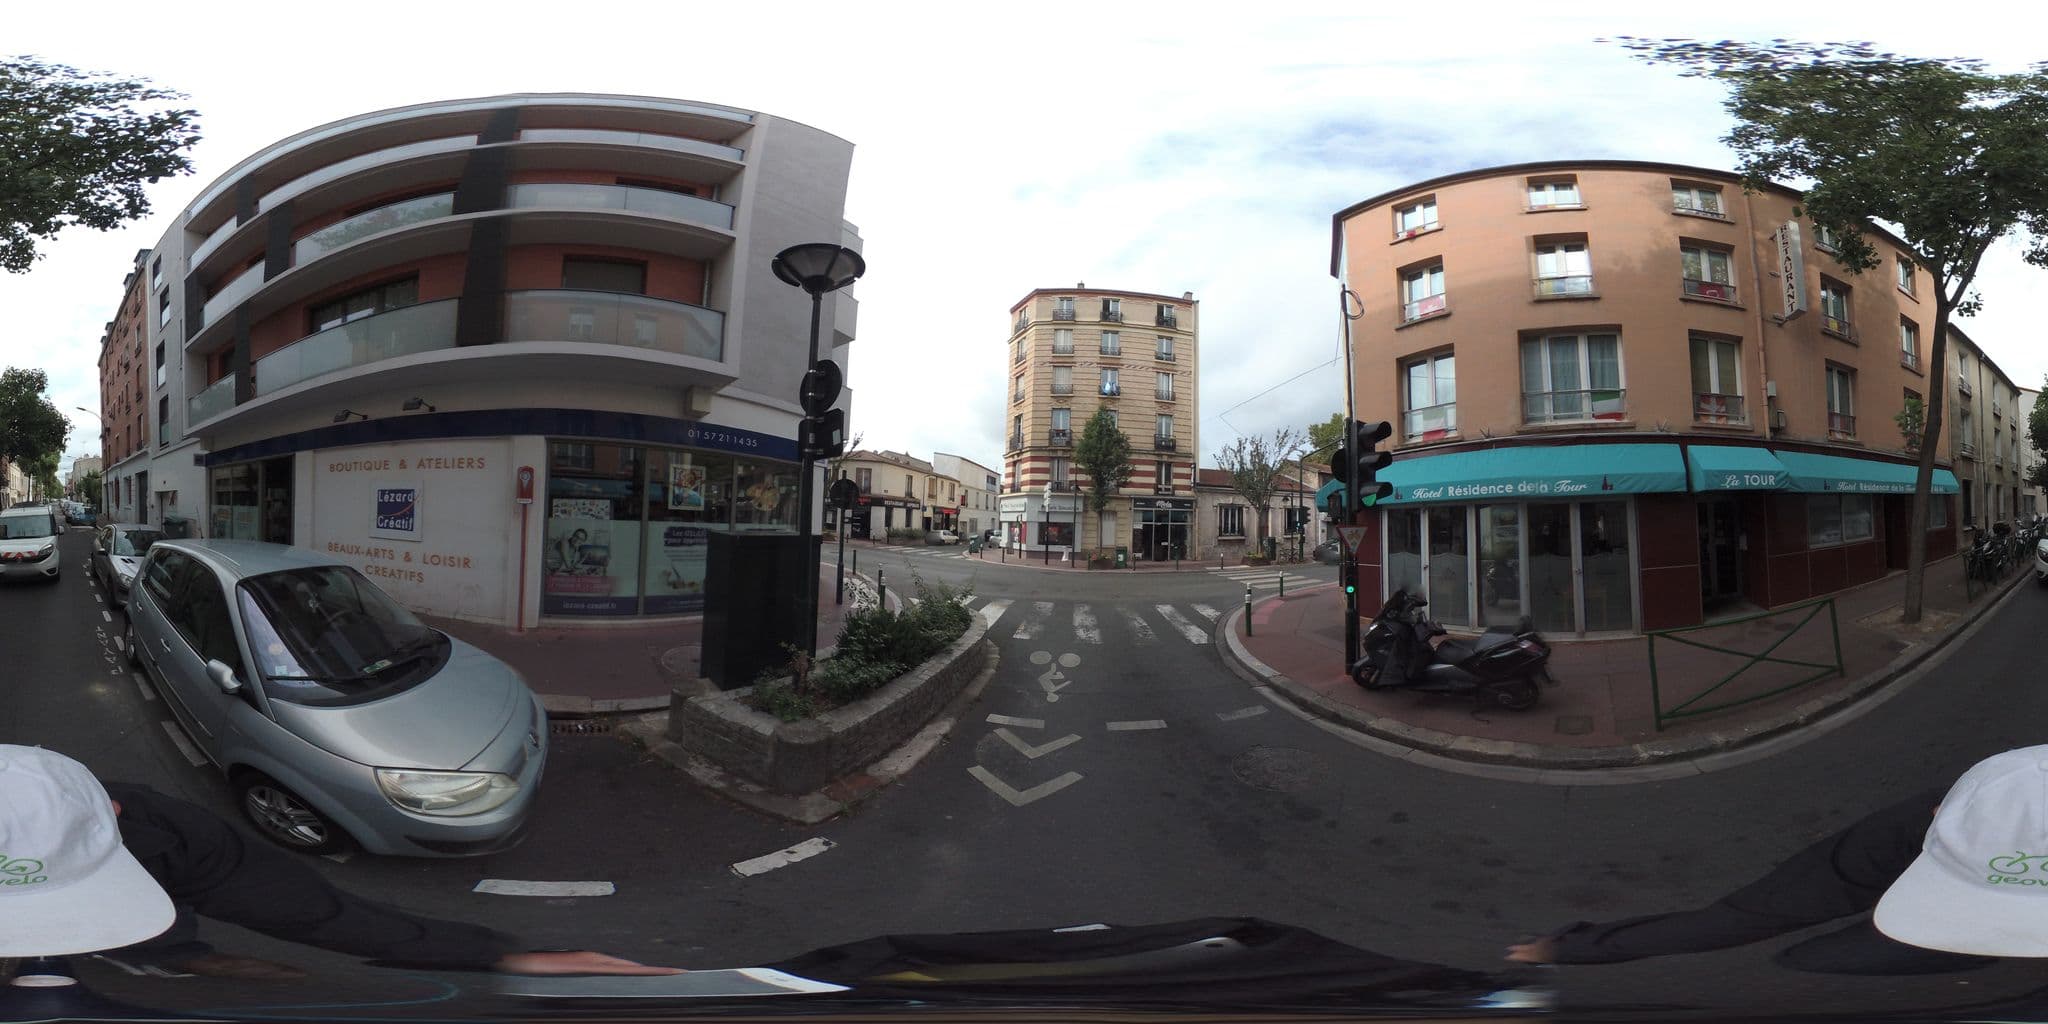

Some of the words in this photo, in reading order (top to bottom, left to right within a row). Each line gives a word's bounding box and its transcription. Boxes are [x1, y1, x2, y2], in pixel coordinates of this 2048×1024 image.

[1779, 223, 1796, 313] RESTAURANT
[329, 460, 391, 473] BOUTIQUE
[399, 459, 408, 470] &
[417, 458, 486, 470] ATELIERS
[1743, 475, 1775, 486] TOUR
[378, 491, 415, 503] Lézard
[1411, 487, 1442, 500] Hotel
[1447, 483, 1513, 497] Résidence
[1553, 479, 1587, 493] Tour
[378, 516, 413, 530] Créatif
[328, 542, 394, 560] BEAUX-ARTS
[404, 552, 412, 562] &
[365, 565, 424, 583] CREATIFS
